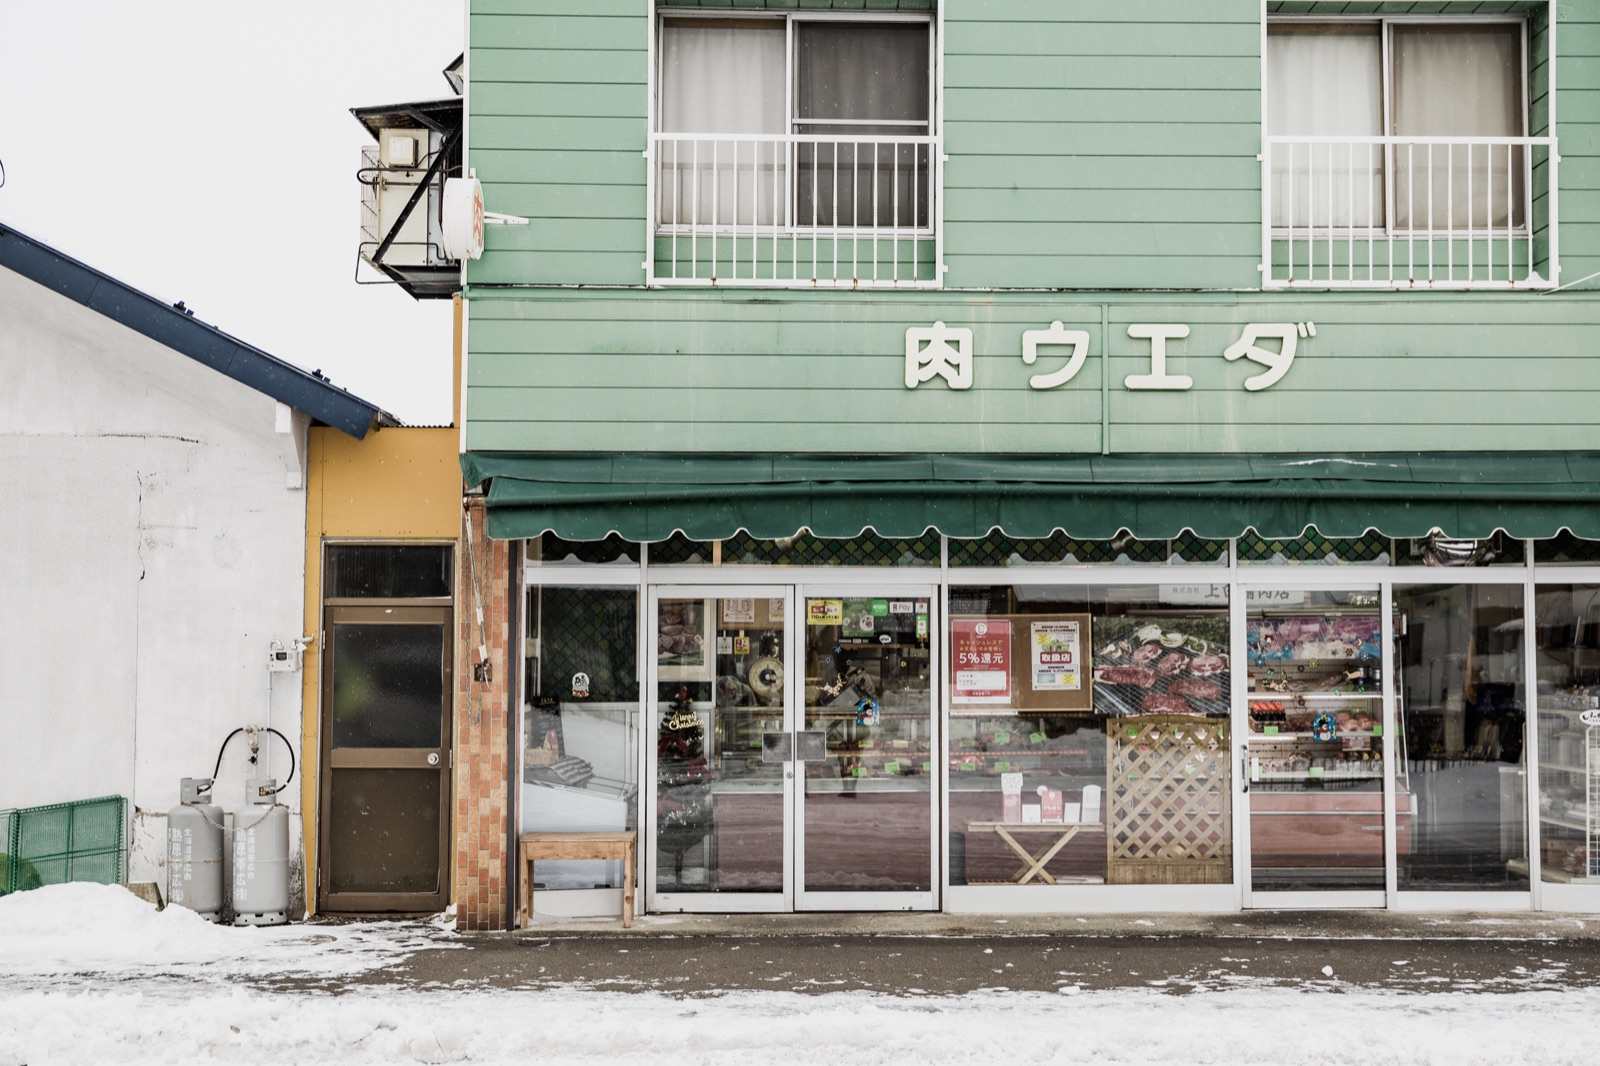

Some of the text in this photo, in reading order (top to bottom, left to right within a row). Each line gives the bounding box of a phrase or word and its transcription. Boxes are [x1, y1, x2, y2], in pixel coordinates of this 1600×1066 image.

[905, 320, 1316, 391] 肉ウエダ
[1172, 586, 1200, 594] 株式会社
[899, 604, 911, 612] Pay
[959, 653, 1004, 664] 5%還元
[1041, 653, 1071, 663] 取扱店
[672, 710, 697, 721] Merry
[668, 718, 705, 731] Christmas
